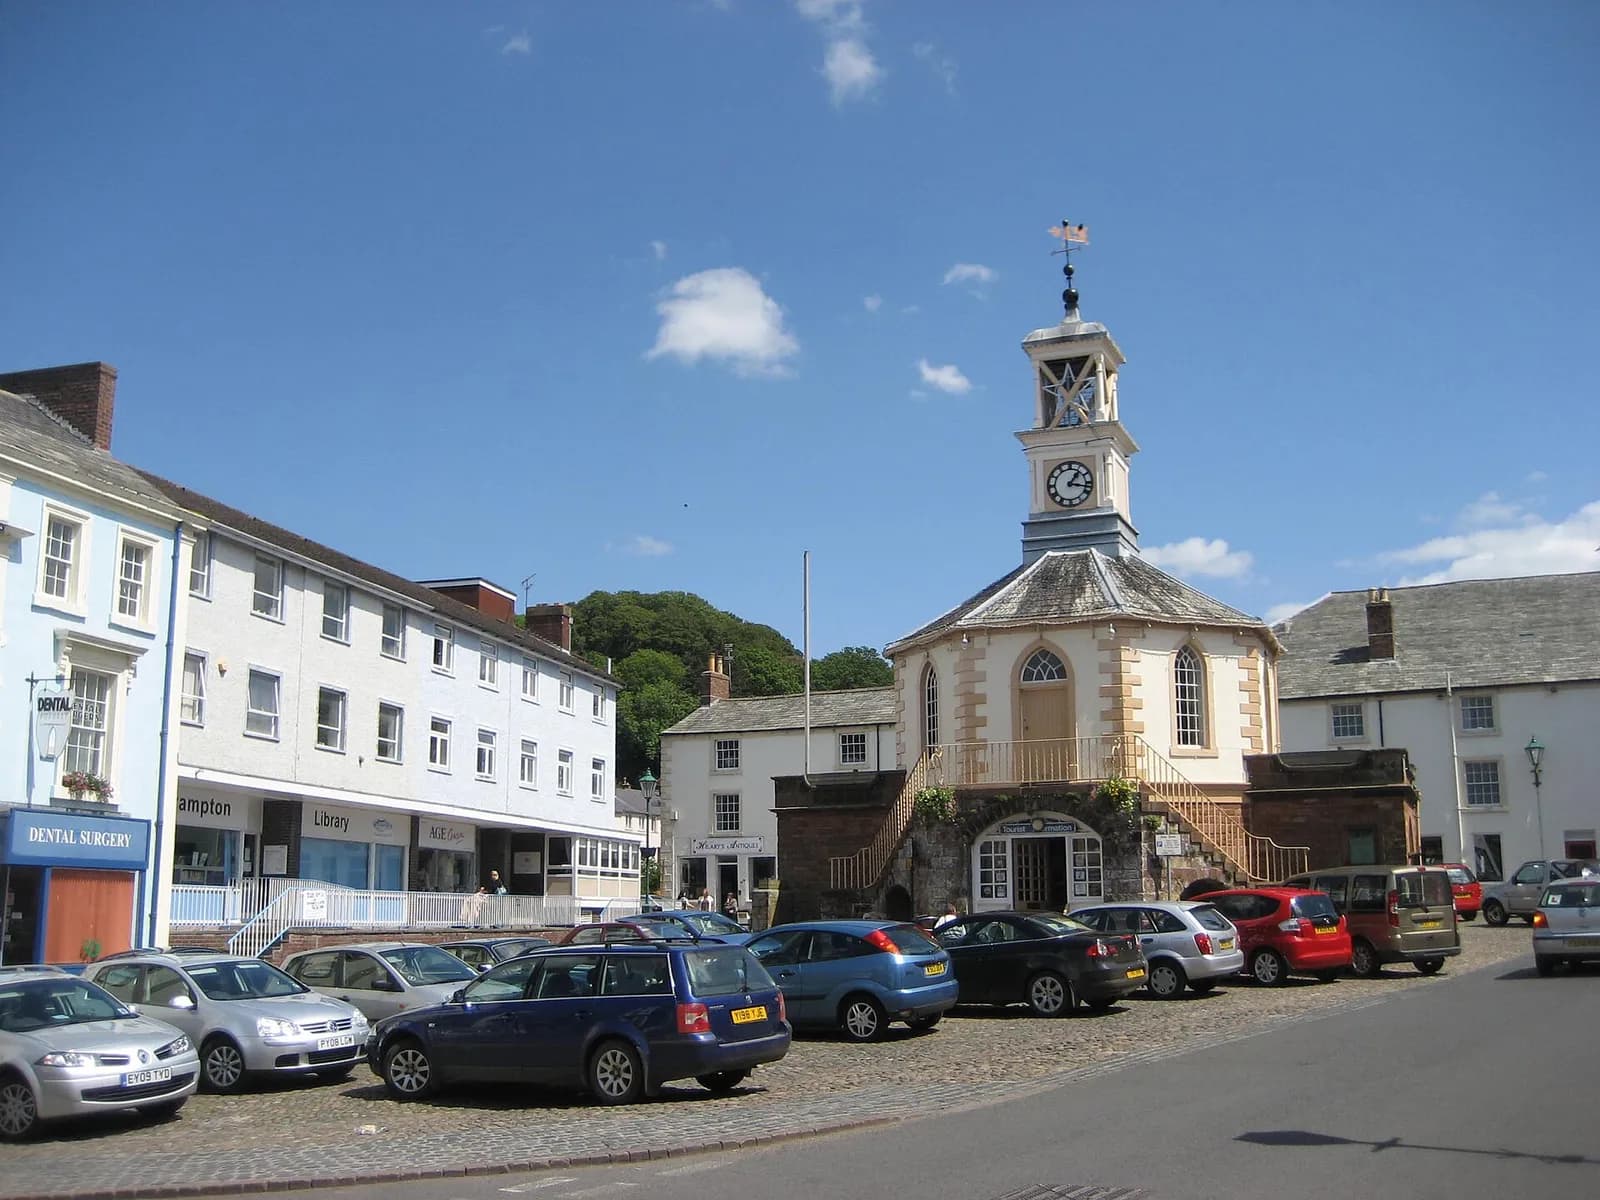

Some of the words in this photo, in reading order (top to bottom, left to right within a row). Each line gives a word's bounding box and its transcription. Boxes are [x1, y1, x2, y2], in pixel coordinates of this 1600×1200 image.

[37, 697, 71, 711] DENTAL
[72, 703, 100, 713] ENTAL
[178, 797, 231, 818] ampton
[314, 810, 350, 833] Library
[29, 827, 77, 844] DENTAL
[79, 830, 132, 848] SURGERY
[429, 825, 447, 840] AGE
[127, 1071, 152, 1084] EY09
[154, 1068, 170, 1081] TYD
